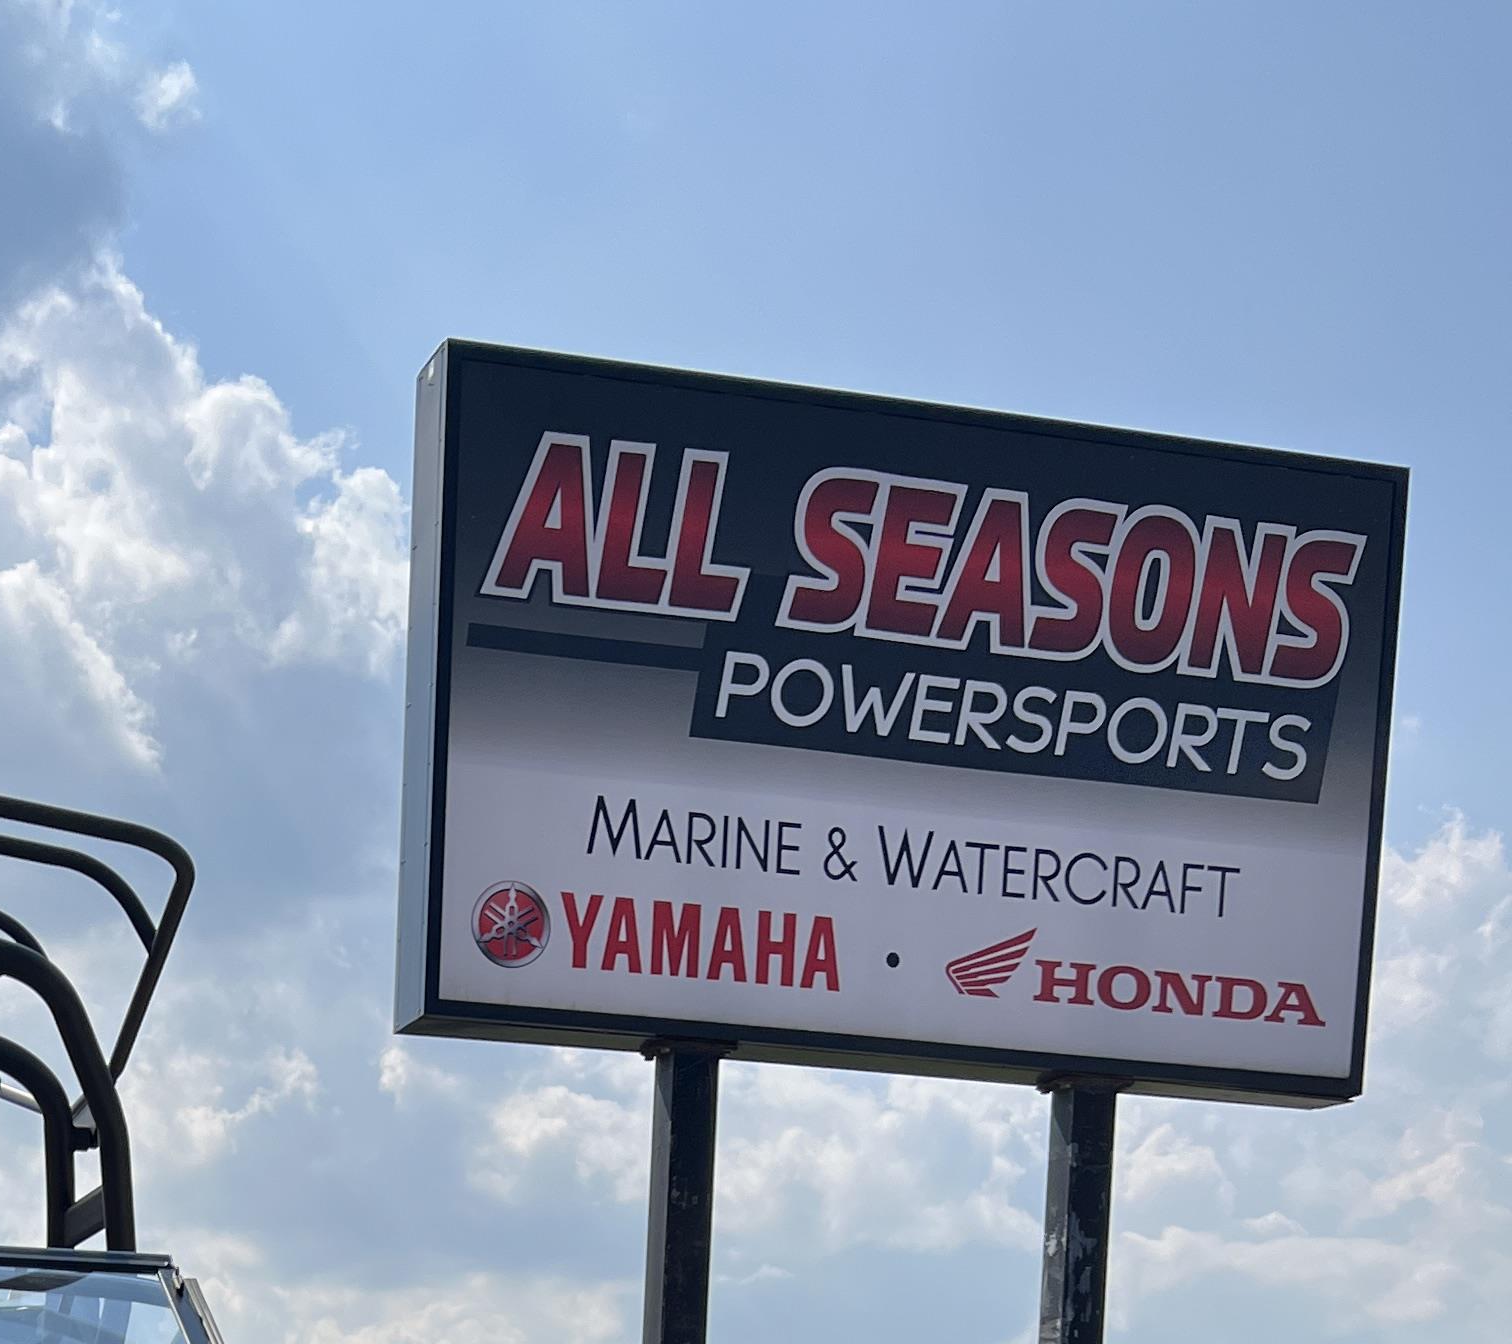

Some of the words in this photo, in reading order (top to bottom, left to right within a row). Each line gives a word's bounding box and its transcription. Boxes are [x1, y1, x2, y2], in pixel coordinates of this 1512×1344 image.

[480, 431, 752, 622] ALL
[776, 466, 1367, 689] SEASONS
[716, 650, 1311, 782] POWERSPORTS
[587, 794, 803, 877] MARINE
[823, 827, 857, 882] &
[877, 826, 1241, 918] WATERCRAFT
[561, 891, 841, 993] YAMAHA
[1034, 959, 1327, 1029] HONDA
